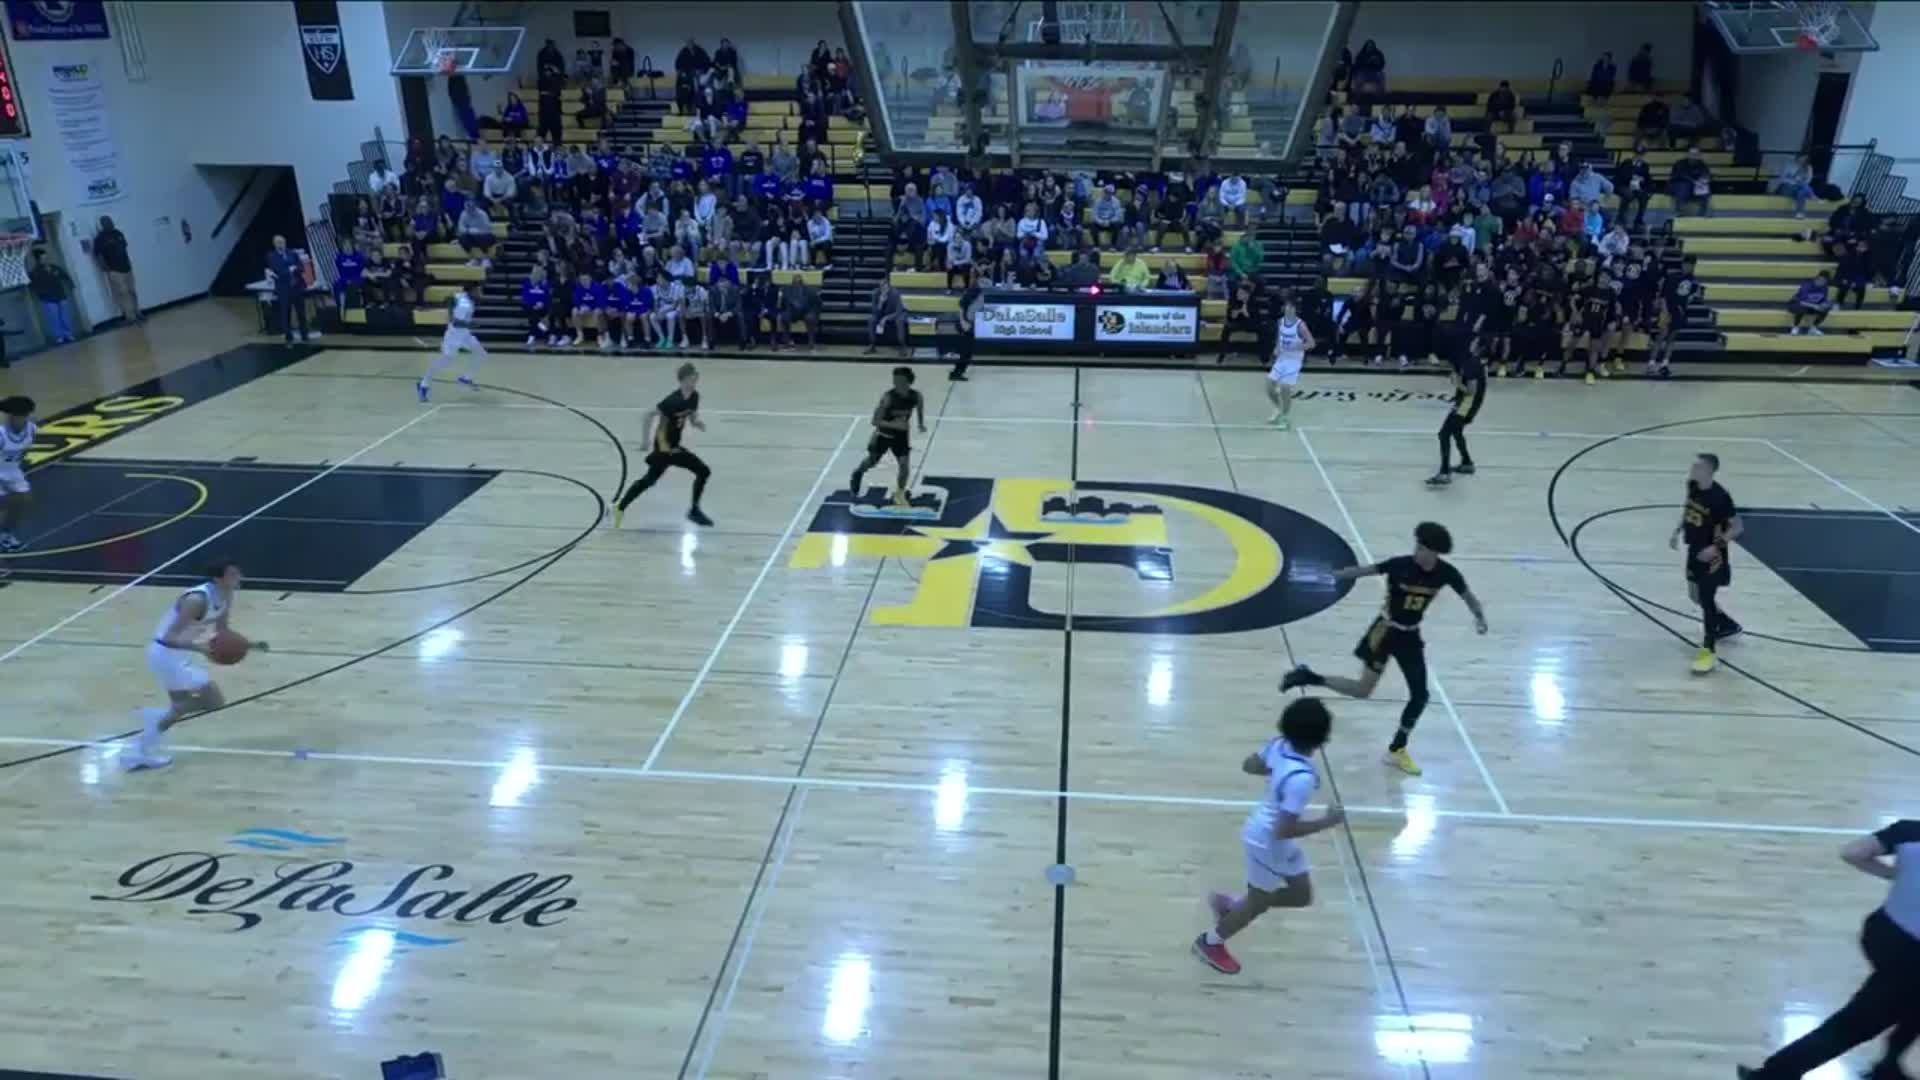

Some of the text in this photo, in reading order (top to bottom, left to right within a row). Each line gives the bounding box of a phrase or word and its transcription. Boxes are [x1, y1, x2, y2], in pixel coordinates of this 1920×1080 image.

[993, 325, 1053, 336] High School
[1128, 321, 1192, 335] Islanders
[91, 851, 577, 931] DeLaSalle
